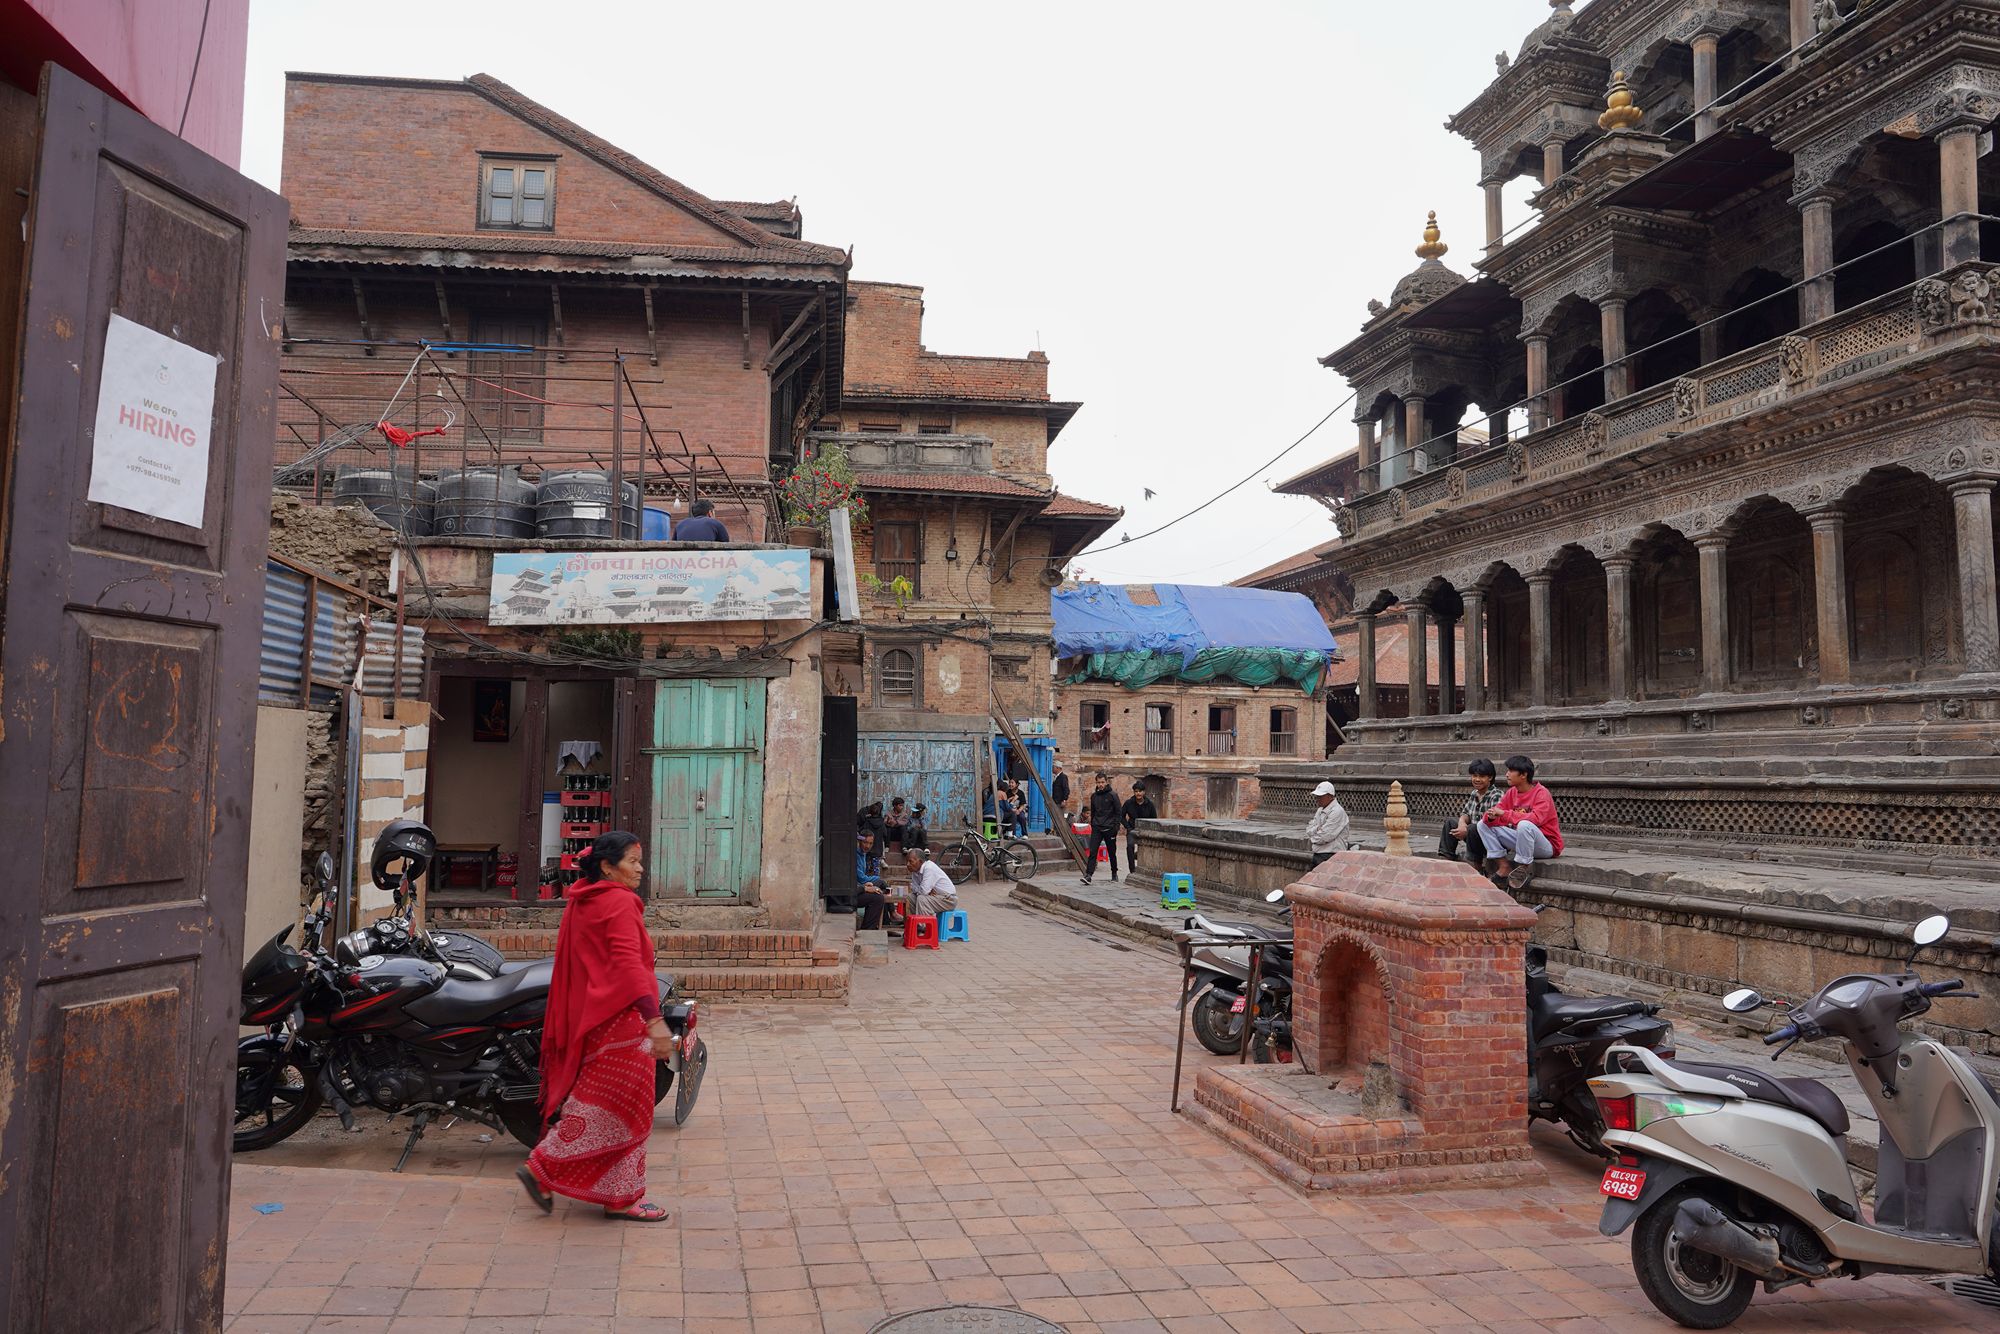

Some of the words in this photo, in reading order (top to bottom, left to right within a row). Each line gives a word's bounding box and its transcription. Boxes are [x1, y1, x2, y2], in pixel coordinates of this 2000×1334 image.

[143, 398, 160, 411] We
[161, 406, 178, 417] are
[119, 404, 196, 447] HIRING
[138, 456, 162, 469] Contact
[641, 556, 738, 570] HONACHA
